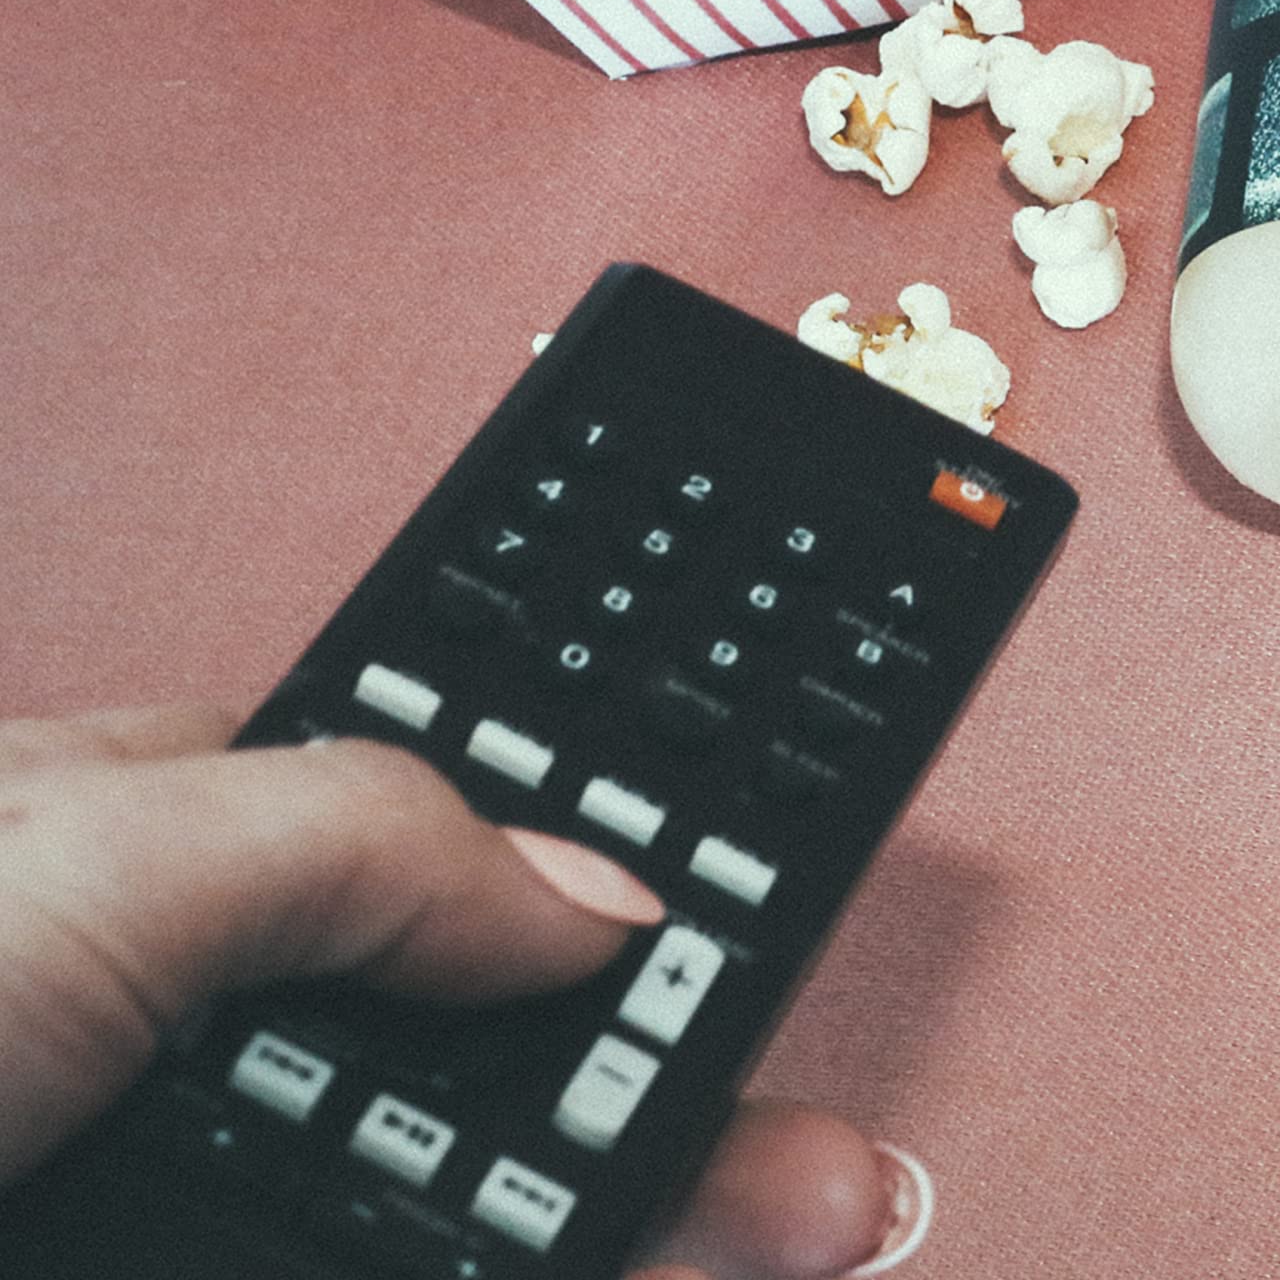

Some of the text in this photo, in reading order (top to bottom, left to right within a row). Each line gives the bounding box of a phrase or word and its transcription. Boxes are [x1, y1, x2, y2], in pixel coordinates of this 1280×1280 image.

[586, 423, 605, 447] 1
[536, 477, 565, 501] 4
[680, 473, 713, 501] 2
[495, 529, 526, 553] 7
[642, 528, 673, 555] 5
[786, 526, 817, 554] 3
[602, 585, 634, 613] 8
